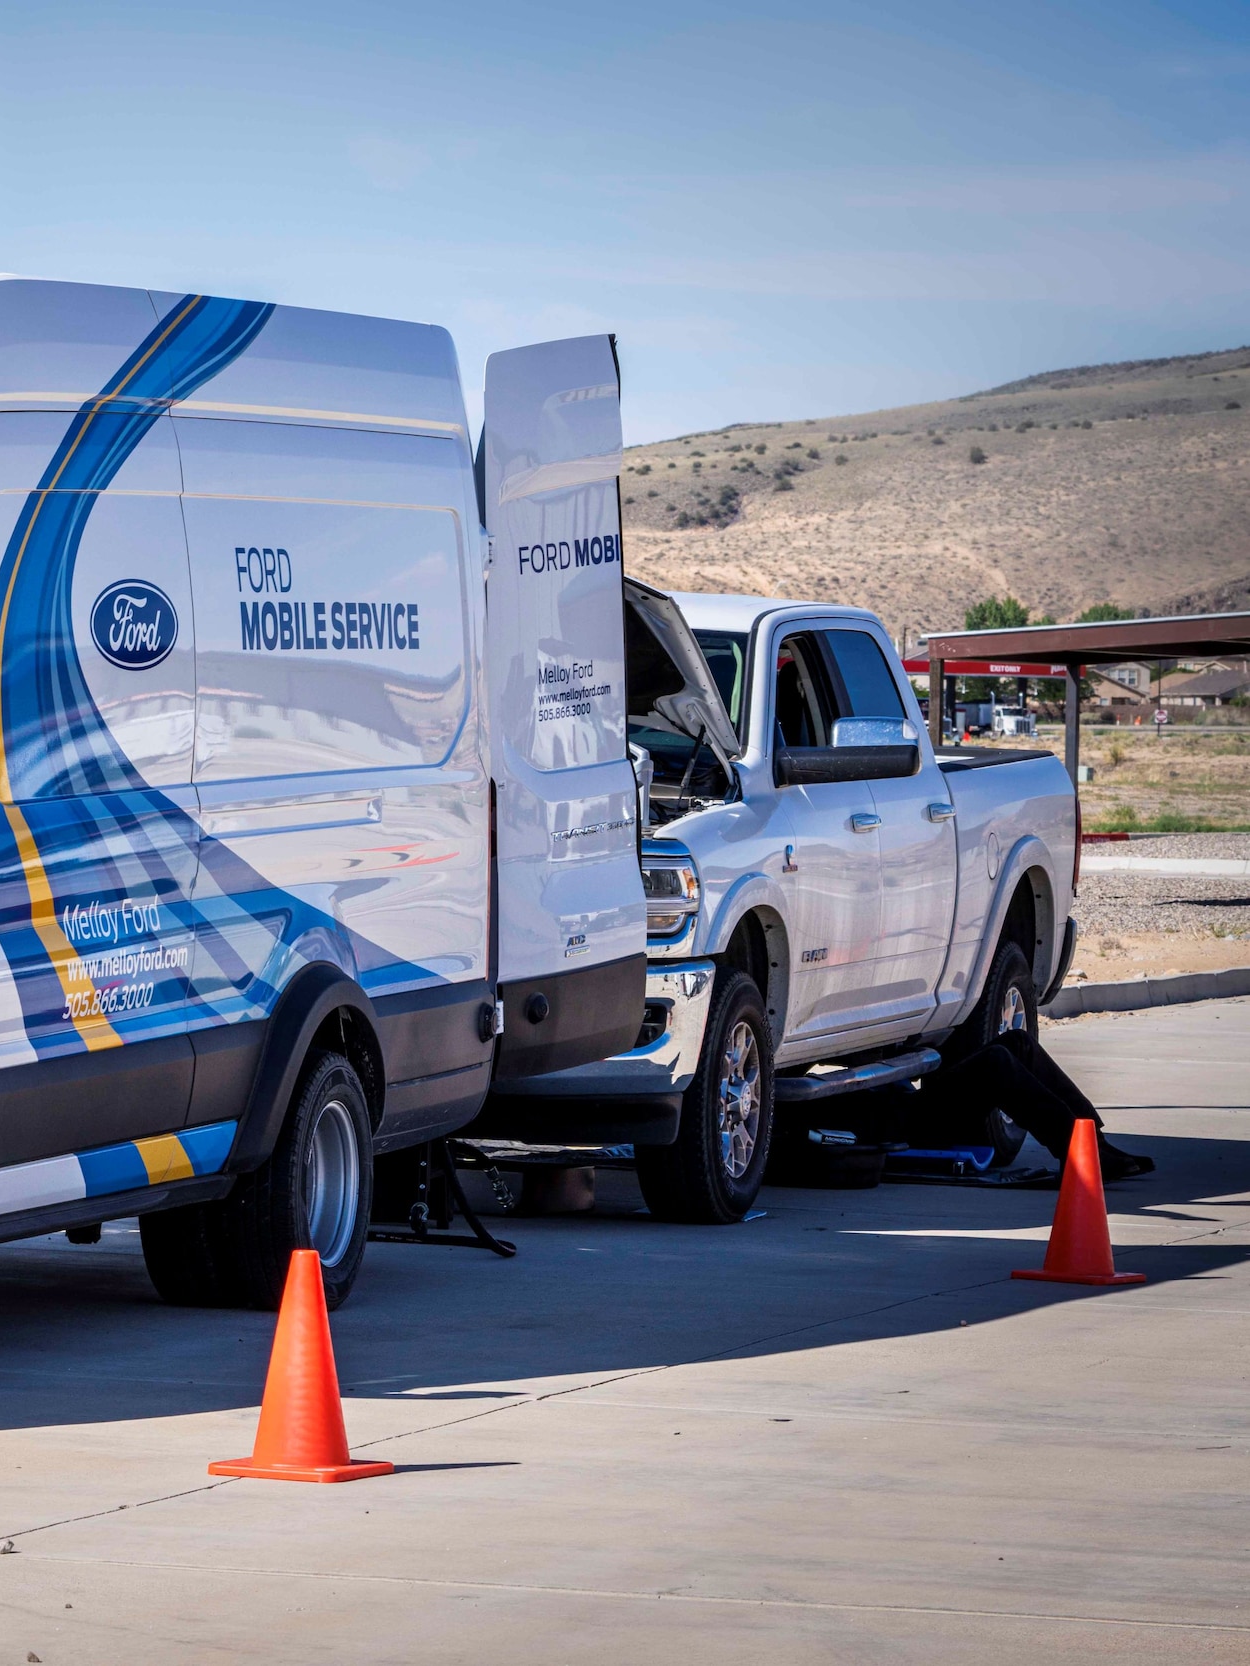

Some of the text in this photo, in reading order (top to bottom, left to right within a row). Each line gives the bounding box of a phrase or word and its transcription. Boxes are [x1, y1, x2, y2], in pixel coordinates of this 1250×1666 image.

[235, 547, 292, 593] FORD
[518, 534, 620, 575] FORD MOBI
[109, 593, 161, 652] Ford
[240, 601, 420, 651] MOBILE SERVICE
[538, 659, 593, 685] Melloy Ford
[990, 664, 1021, 673] EXIT ONLY
[538, 684, 611, 706] www.melloyford.com
[538, 702, 591, 722] 505.866.3000
[62, 894, 161, 944] Melloy Ford
[67, 945, 188, 982] www.melloyford.com
[62, 982, 154, 1020] 505.866.3000
